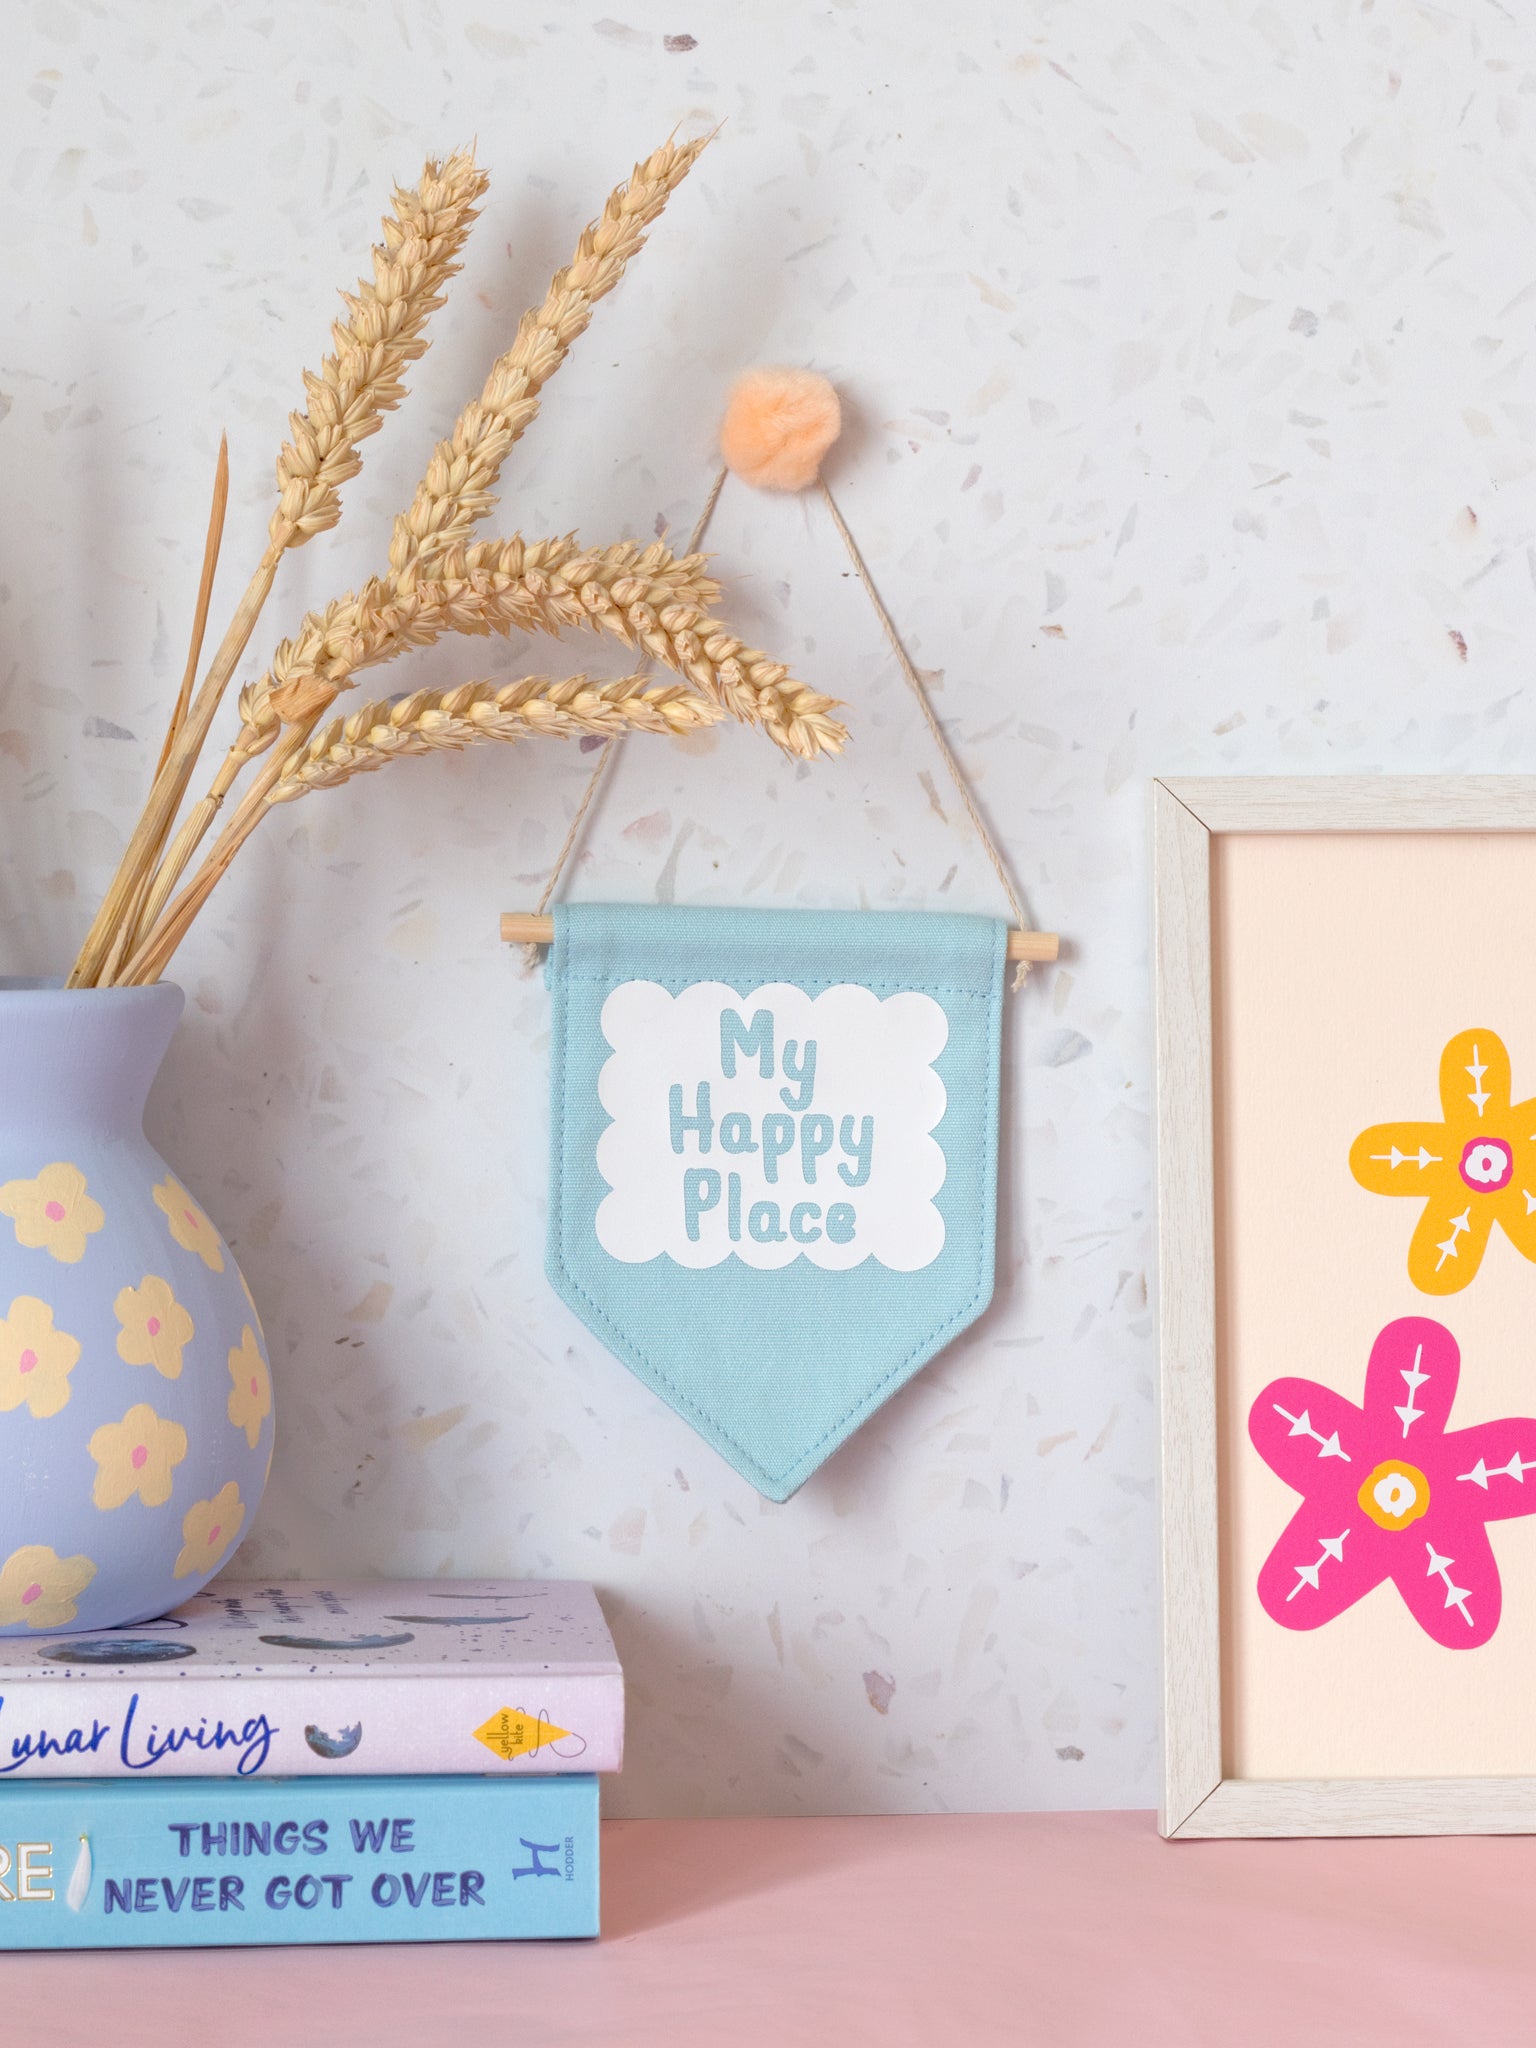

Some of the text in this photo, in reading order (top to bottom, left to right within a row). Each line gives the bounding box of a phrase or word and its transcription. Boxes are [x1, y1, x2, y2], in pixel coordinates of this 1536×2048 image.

[720, 1008, 817, 1111] My
[669, 1081, 875, 1187] Happy
[684, 1168, 857, 1244] Place
[120, 1693, 280, 1775] Living
[486, 1713, 514, 1761] yellow
[510, 1724, 524, 1745] kite
[169, 1818, 415, 1857] THINGS WE
[564, 1836, 574, 1881] HODDER
[104, 1871, 486, 1914] NEVER GOT OVER
